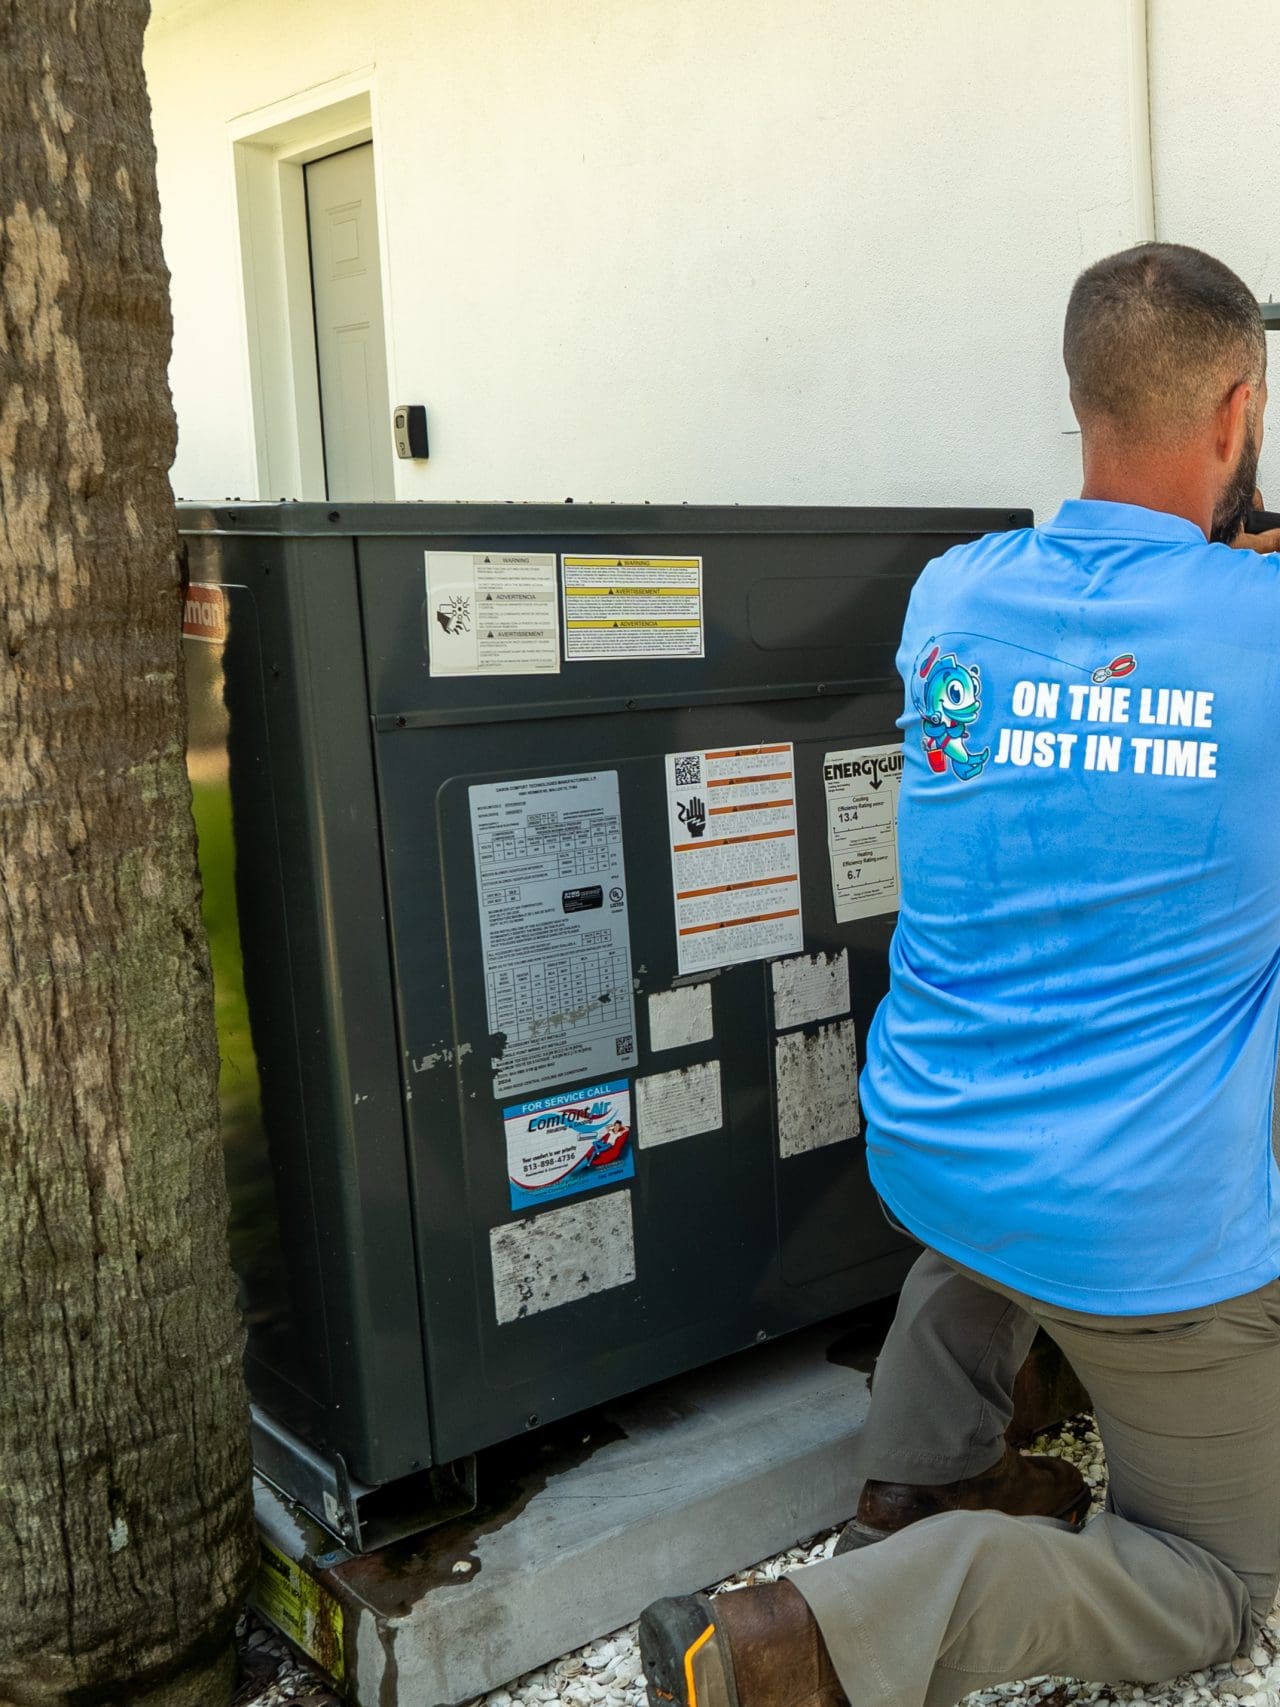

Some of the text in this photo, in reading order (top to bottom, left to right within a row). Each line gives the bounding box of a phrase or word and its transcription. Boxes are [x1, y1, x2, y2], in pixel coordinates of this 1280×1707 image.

[184, 600, 221, 627] man
[1011, 681, 1215, 728] ON THE LINE
[994, 728, 1219, 778] JUST IN TIME
[824, 755, 904, 781] ENERGYGUI
[838, 812, 858, 823] 13.4
[847, 868, 861, 880] 6.7
[522, 1086, 612, 1113] FOR SERVICE CALL
[523, 1152, 576, 1173] 813-898-4736
